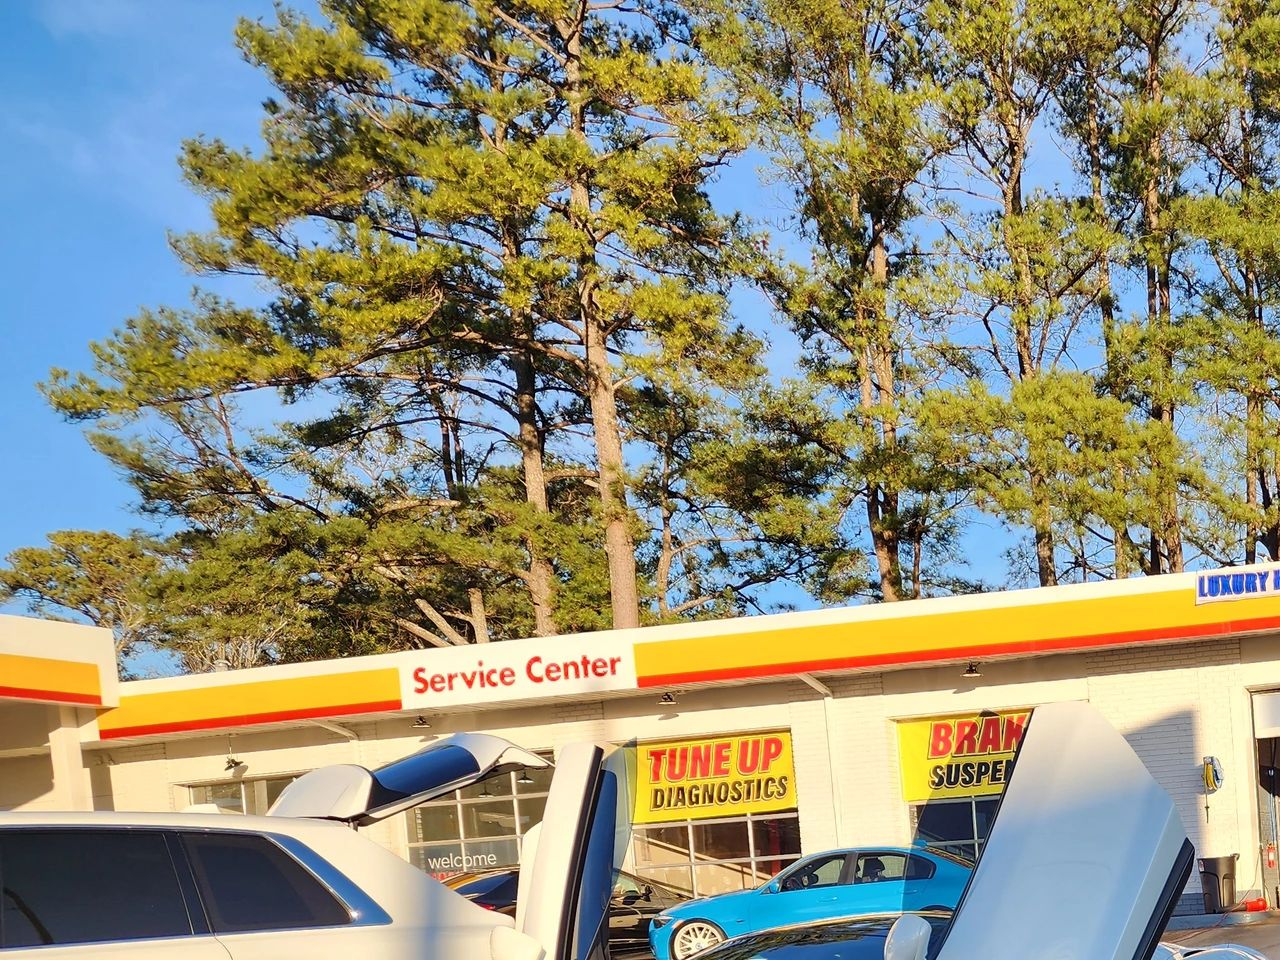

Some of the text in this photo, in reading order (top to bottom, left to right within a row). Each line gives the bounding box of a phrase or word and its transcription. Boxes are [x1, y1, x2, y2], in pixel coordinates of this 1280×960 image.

[1198, 570, 1270, 598] LUXURY
[413, 654, 621, 694] Service Center
[648, 736, 783, 783] TUNE UP
[652, 776, 788, 810] DIAGNOSTICS
[428, 853, 497, 869] welcome
